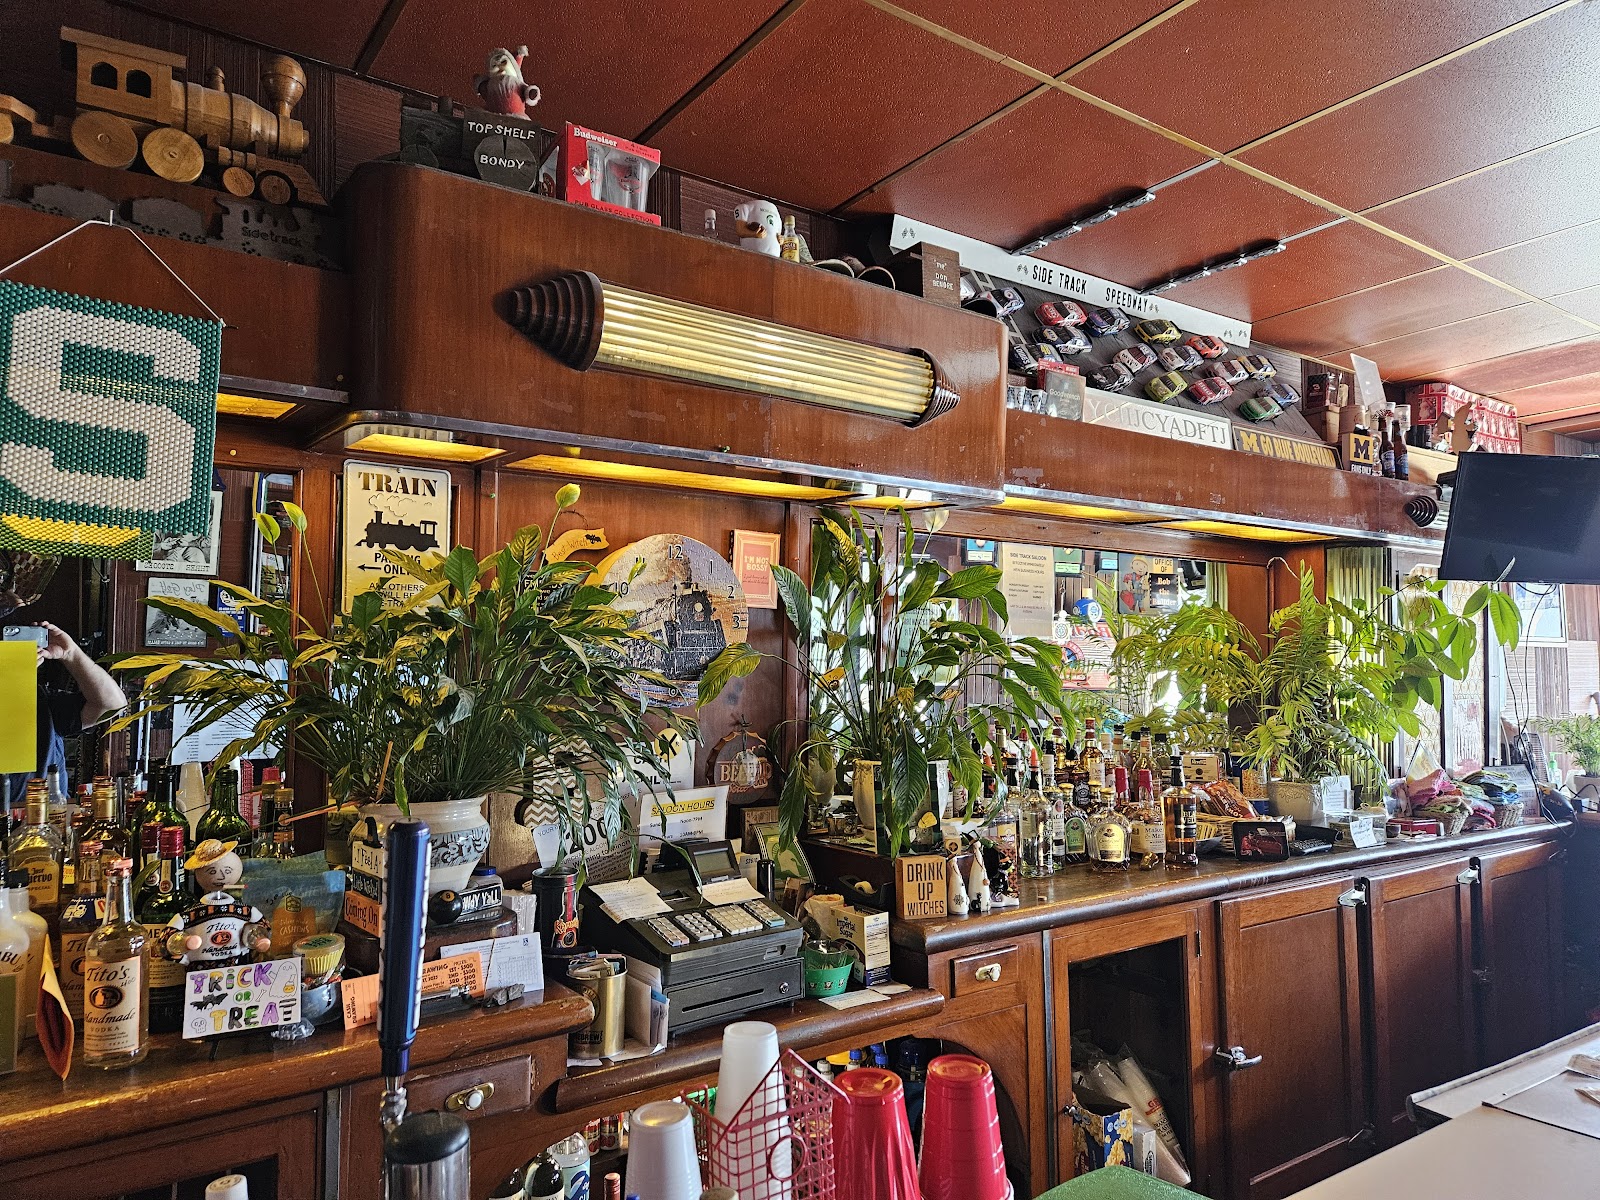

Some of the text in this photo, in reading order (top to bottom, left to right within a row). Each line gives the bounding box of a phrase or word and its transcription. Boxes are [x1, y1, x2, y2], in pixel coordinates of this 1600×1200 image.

[468, 121, 536, 140] TOP SHELF
[573, 127, 618, 147] Budweiser
[479, 154, 525, 170] BONDY
[574, 200, 655, 224] PUB GLASS COLLECTION
[1032, 264, 1149, 313] SIDE TRACK SPEEDWAY
[1260, 434, 1272, 457] GO
[1274, 437, 1294, 461] BLUE
[1294, 440, 1337, 469] BOULEVARD
[1353, 437, 1370, 461] M
[358, 471, 438, 497] TRAIN
[668, 545, 683, 560] 12
[744, 555, 769, 565] I'M NOT
[384, 564, 413, 576] ONL
[709, 559, 714, 575] 1
[746, 563, 768, 571] BOSSY
[1154, 558, 1173, 567] OFFICE
[388, 583, 425, 592] OTHERS
[614, 581, 629, 596] 10
[1157, 577, 1171, 585] Bob
[728, 585, 735, 599] 2
[732, 614, 740, 630] 3
[687, 799, 715, 811] HOURS
[360, 850, 373, 871] Feel
[28, 873, 53, 883] uervo
[32, 867, 44, 875] Jose
[907, 861, 944, 883] DRINK
[917, 882, 934, 901] UP
[345, 897, 378, 929] Coming On
[907, 900, 945, 916] WITCHES
[207, 922, 236, 933] Tito's
[836, 917, 856, 932] Imperial
[839, 926, 854, 939] Sugar
[86, 965, 131, 981] Tito's
[234, 990, 252, 1002] OR
[210, 998, 297, 1032] TREAT
